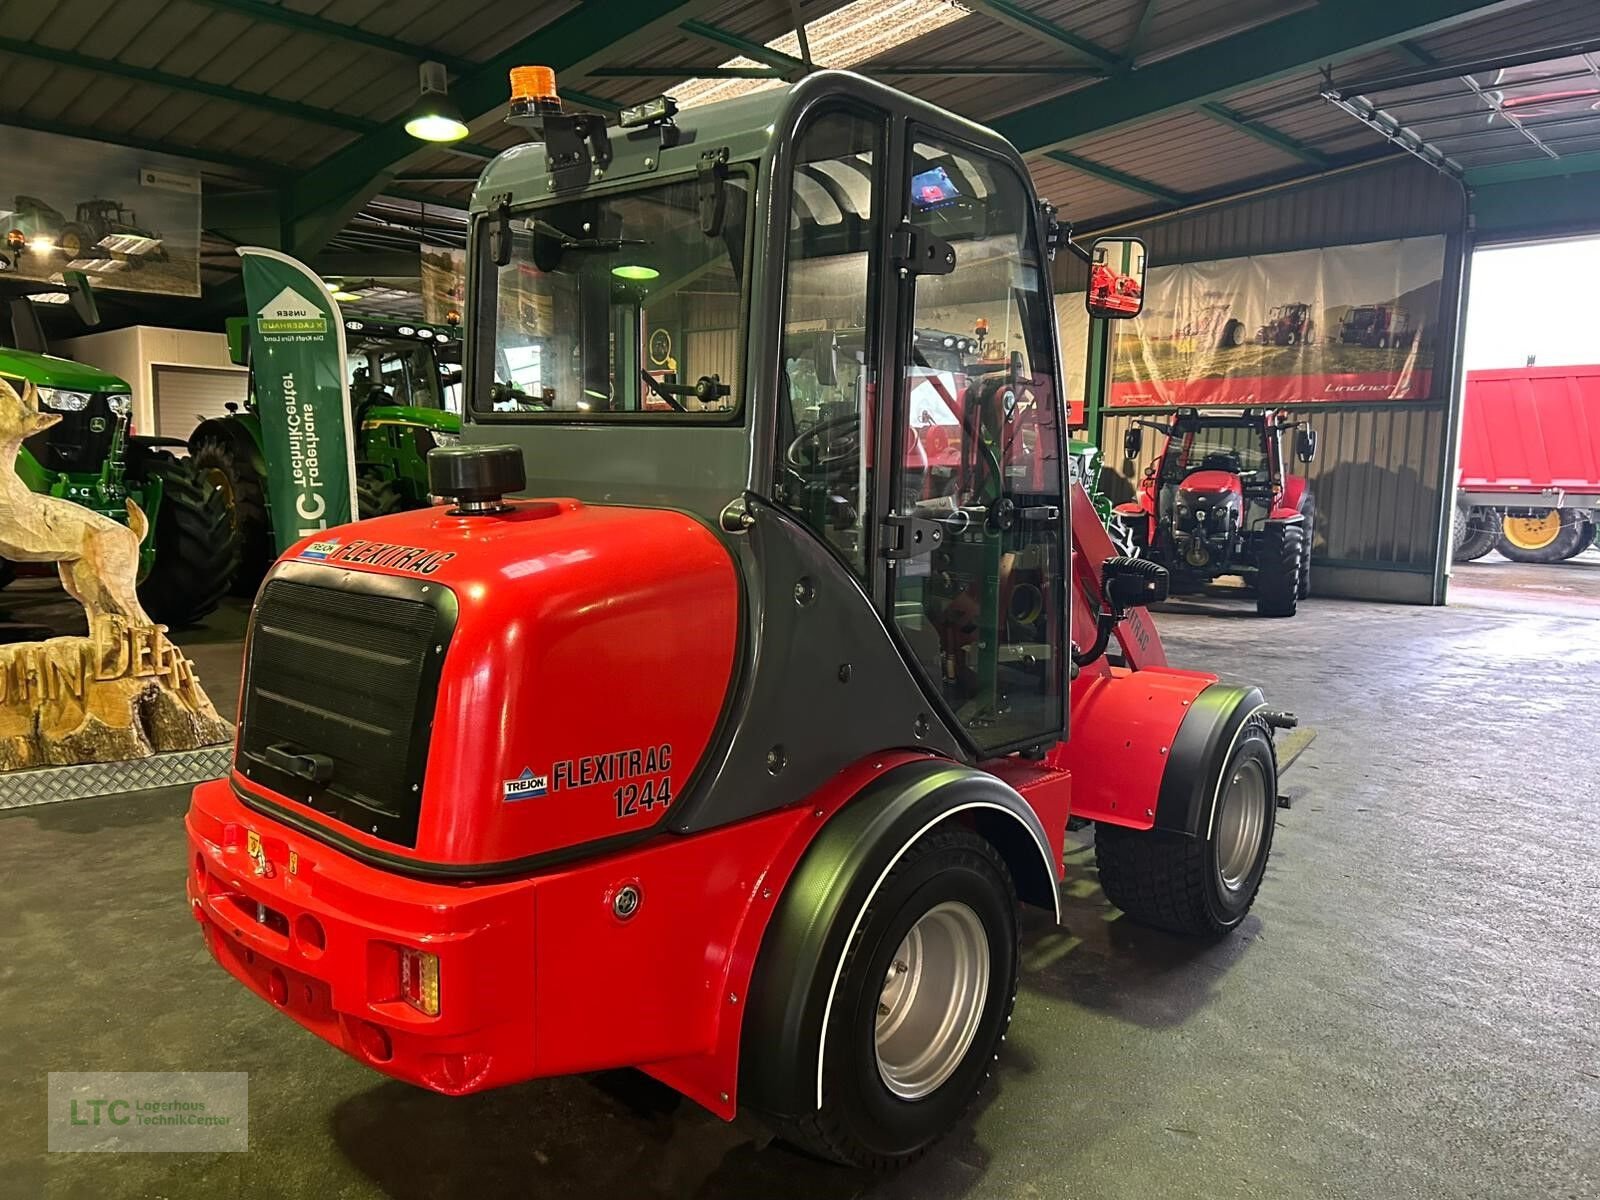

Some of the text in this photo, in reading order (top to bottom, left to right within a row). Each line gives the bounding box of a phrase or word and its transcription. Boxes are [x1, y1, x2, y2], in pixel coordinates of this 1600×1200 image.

[1325, 383, 1396, 394] Lindner
[331, 540, 456, 575] FLEXITRAC
[553, 744, 672, 791] FLEXITRAC
[614, 776, 672, 819] 1244
